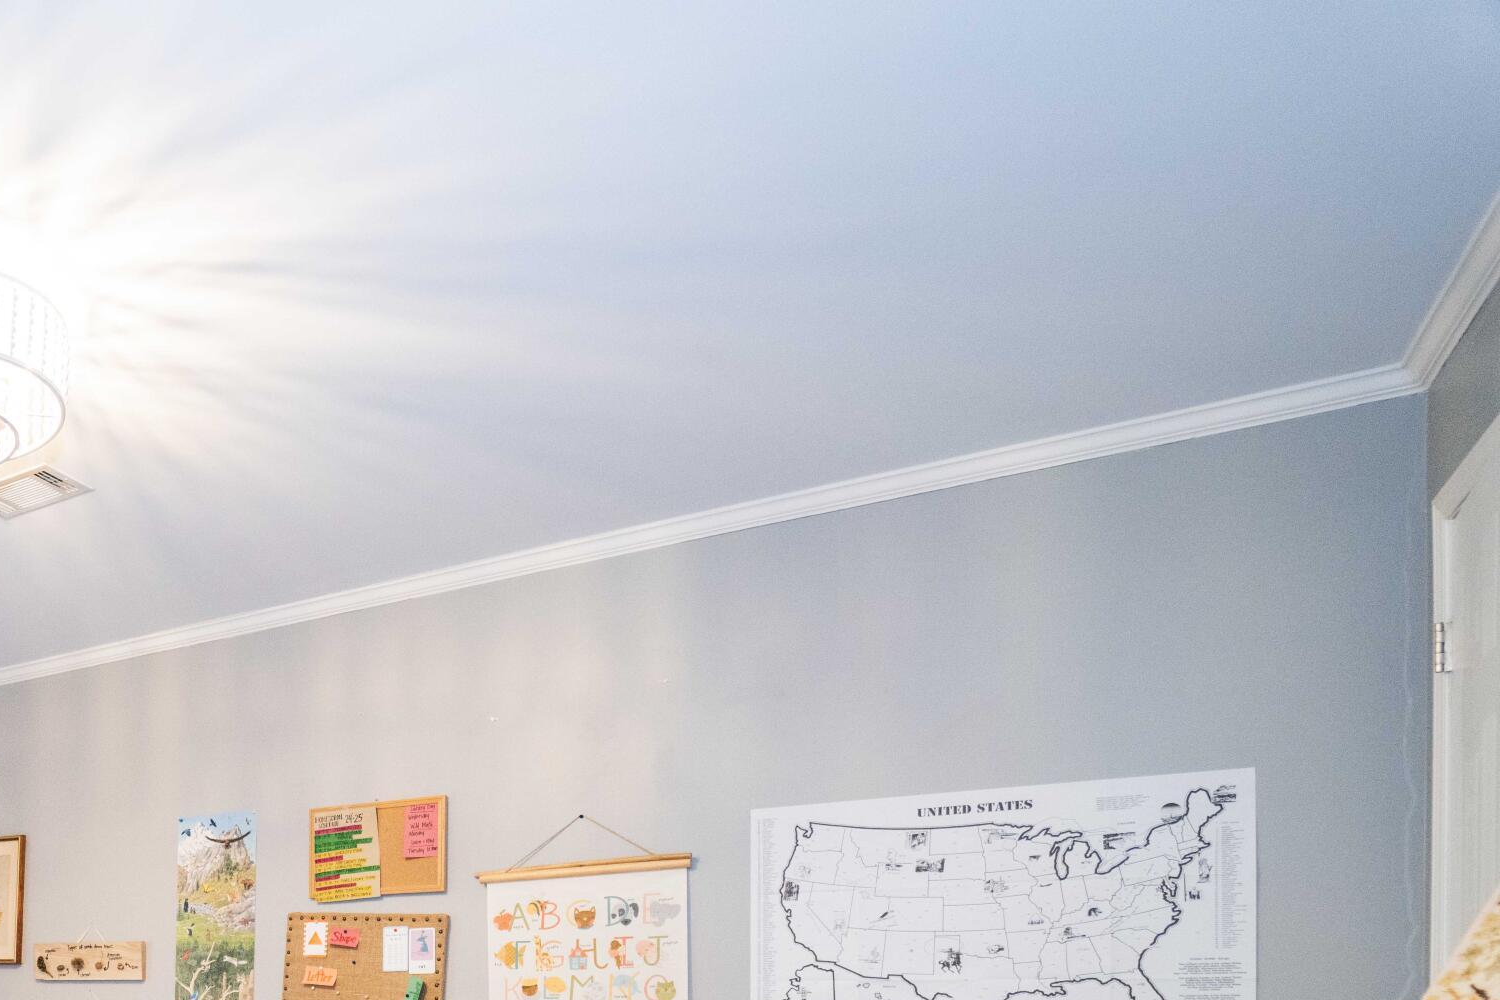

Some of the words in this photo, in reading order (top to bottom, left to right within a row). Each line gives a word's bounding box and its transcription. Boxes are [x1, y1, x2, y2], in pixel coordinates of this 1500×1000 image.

[917, 804, 971, 818] UNITED
[977, 799, 1033, 814] STATES
[508, 902, 530, 931] A
[538, 900, 561, 930] B
[604, 895, 630, 927] D
[643, 935, 669, 967] J
